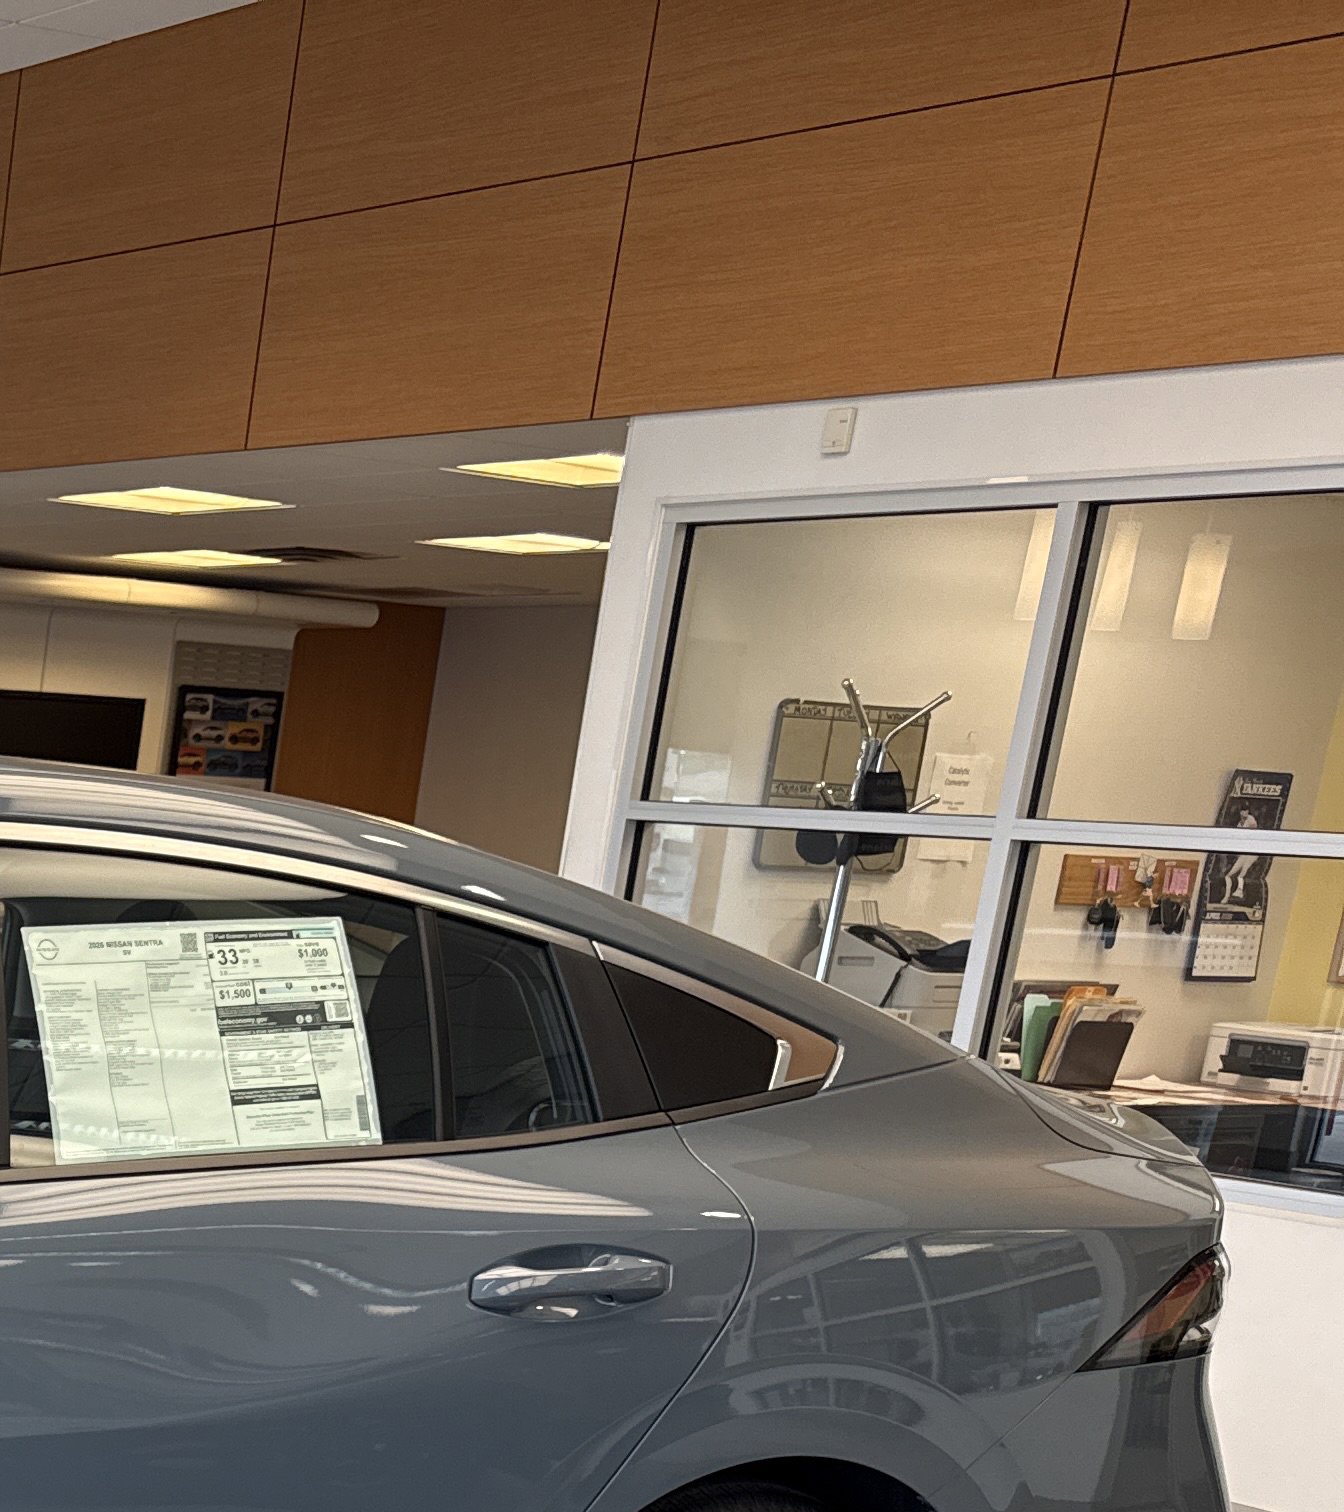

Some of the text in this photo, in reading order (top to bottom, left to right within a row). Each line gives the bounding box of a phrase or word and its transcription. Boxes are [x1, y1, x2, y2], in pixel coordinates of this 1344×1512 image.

[1230, 776, 1283, 797] YANKEES
[134, 939, 163, 947] SENTRA
[216, 948, 239, 966] 33
[297, 947, 328, 959] $1,000
[218, 988, 251, 1001] $1,500
